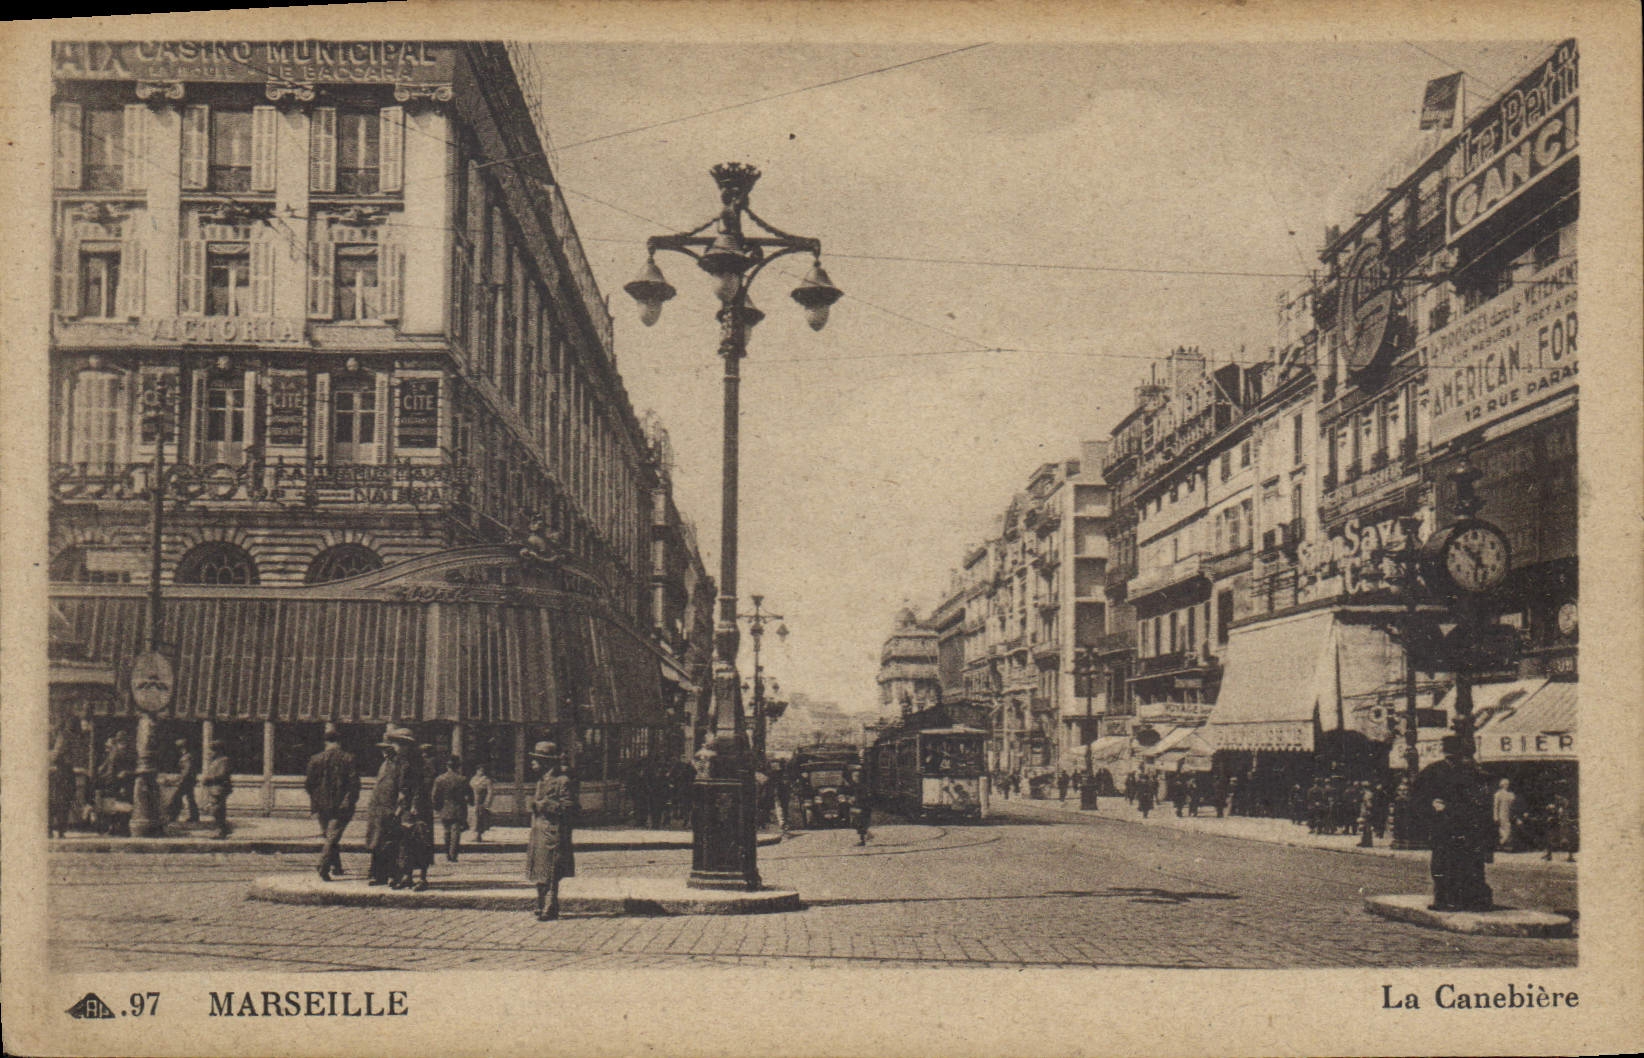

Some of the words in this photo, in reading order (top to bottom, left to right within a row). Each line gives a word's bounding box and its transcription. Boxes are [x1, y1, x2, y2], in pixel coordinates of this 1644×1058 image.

[136, 41, 252, 63] CASINO
[266, 41, 437, 65] MUNICIPAL
[151, 317, 301, 342] VICTORIA
[1433, 340, 1521, 417] AMERICAN
[1539, 310, 1579, 370] FOR
[402, 394, 435, 411] CITE
[1464, 404, 1482, 422] 12
[1487, 387, 1520, 412] RUE
[1500, 734, 1575, 752] BIER
